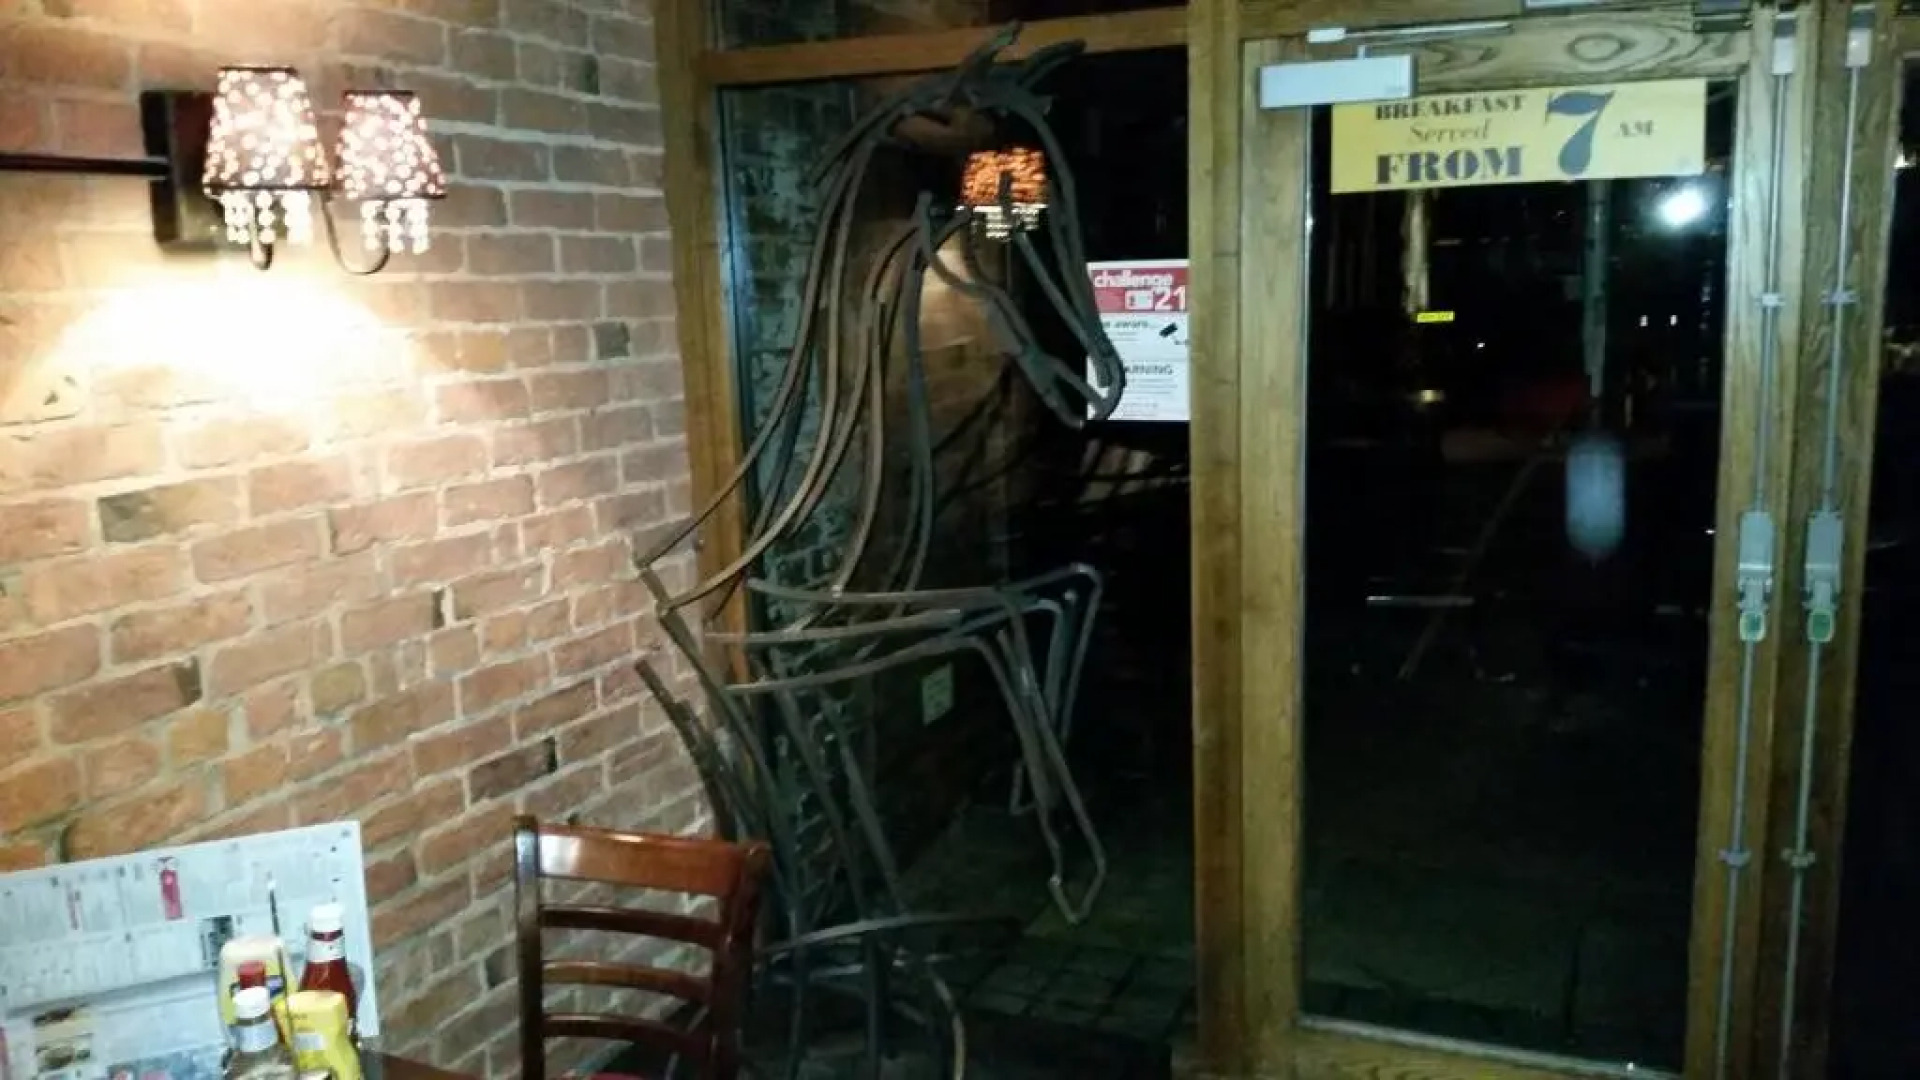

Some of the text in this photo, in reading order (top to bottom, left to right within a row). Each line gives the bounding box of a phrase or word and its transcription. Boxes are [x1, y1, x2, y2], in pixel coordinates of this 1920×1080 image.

[1375, 94, 1525, 120] BREAKFAST
[1408, 118, 1491, 144] Served
[1544, 89, 1654, 176] 7 AM
[1375, 146, 1523, 185] FROM
[1094, 269, 1173, 289] challenge
[1154, 285, 1186, 311] 21
[1123, 364, 1174, 376] ARNING
